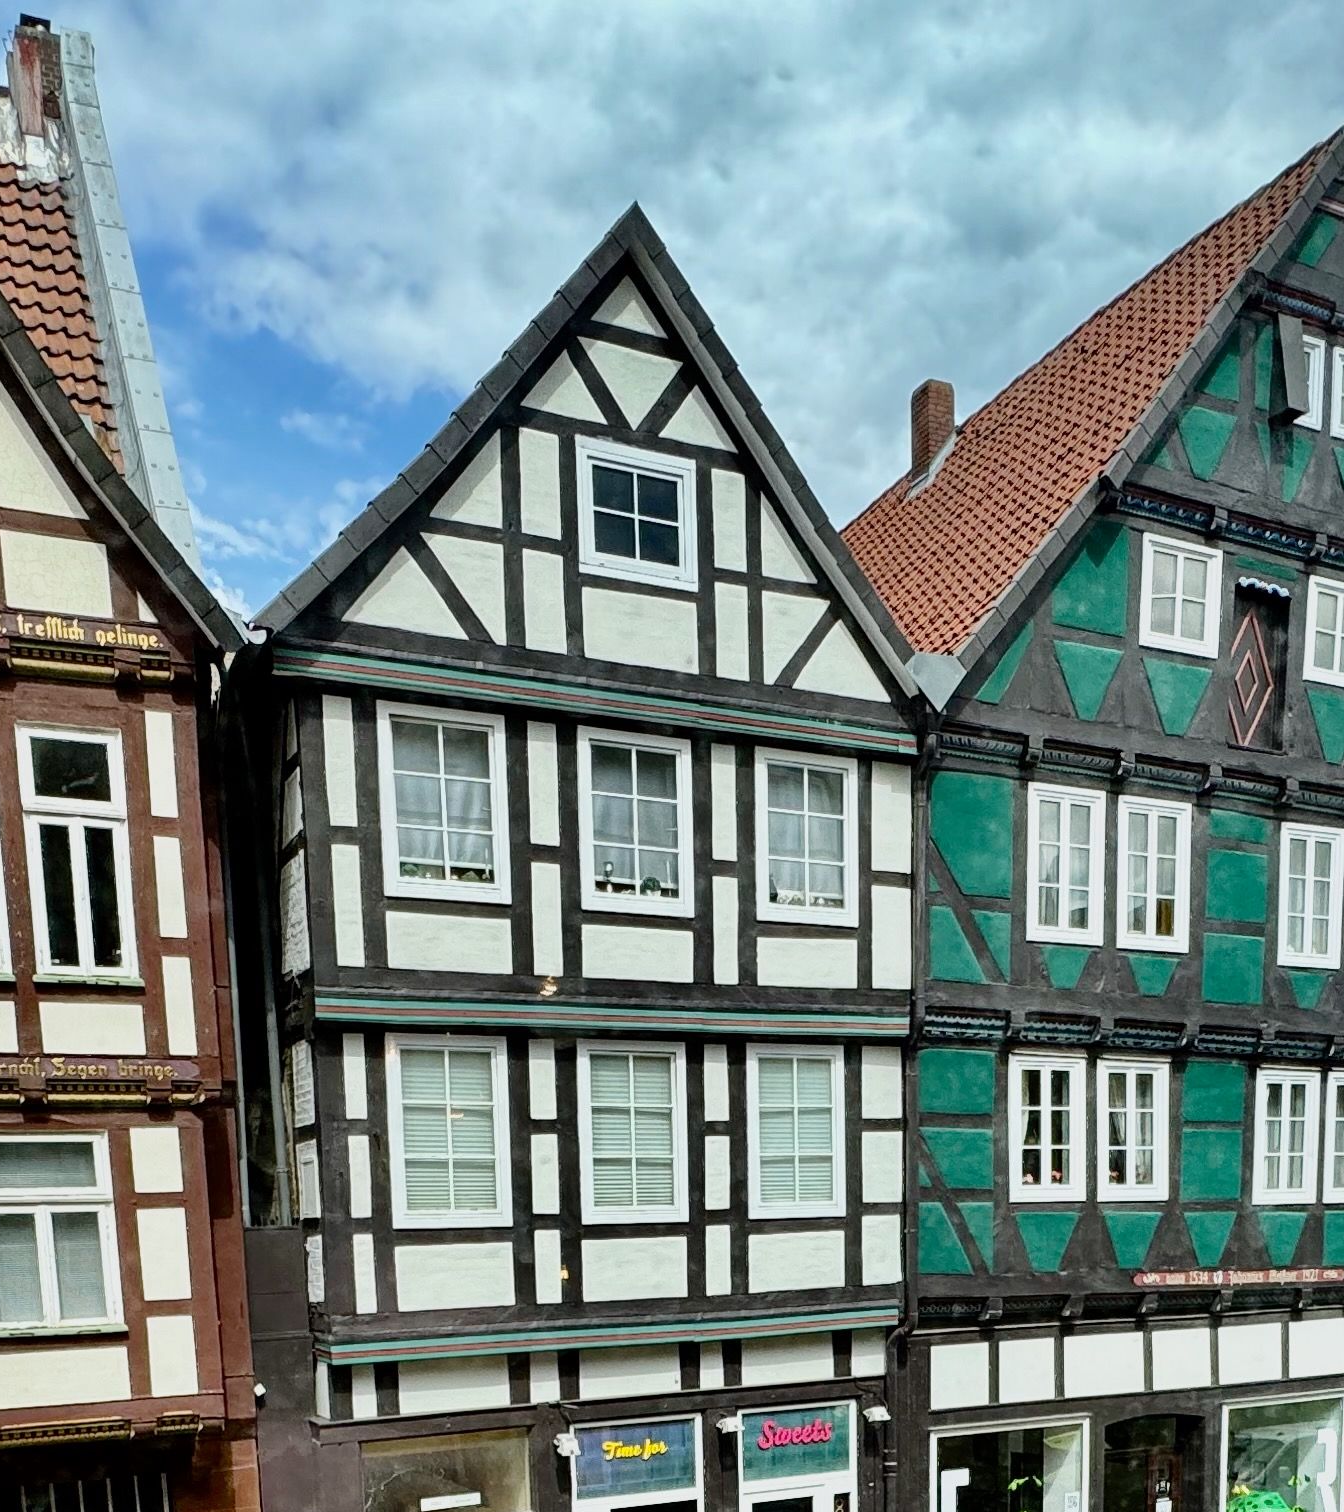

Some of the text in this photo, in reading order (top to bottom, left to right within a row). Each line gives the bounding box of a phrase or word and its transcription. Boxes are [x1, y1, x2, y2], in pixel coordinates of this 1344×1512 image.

[51, 1057, 108, 1081] Segen
[757, 1418, 833, 1451] Sweets
[601, 1437, 668, 1462] Time for
